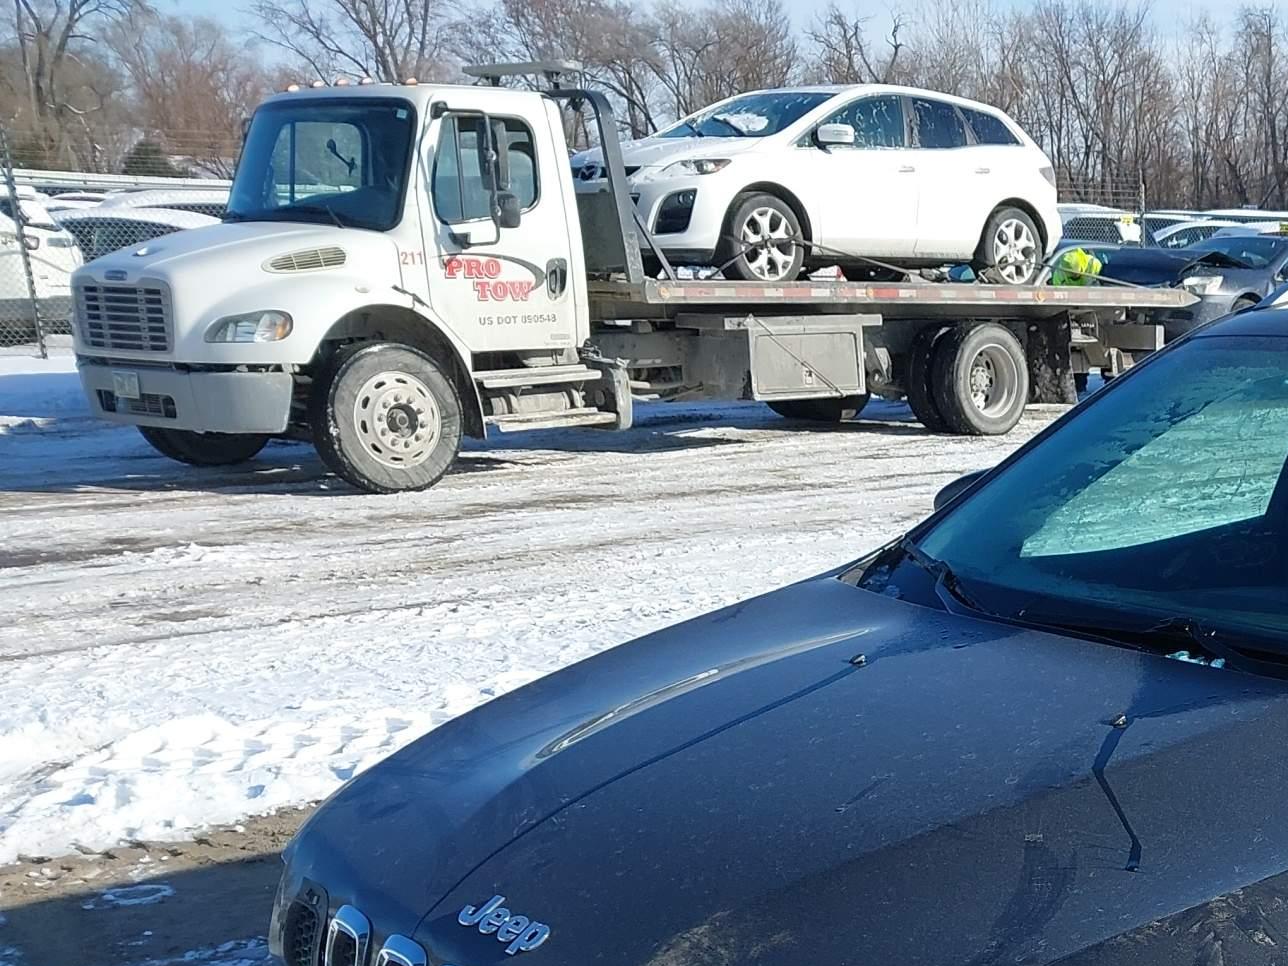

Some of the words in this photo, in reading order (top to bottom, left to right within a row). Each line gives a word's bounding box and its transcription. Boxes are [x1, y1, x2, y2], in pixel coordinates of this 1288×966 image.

[400, 251, 424, 265] 211
[445, 256, 501, 279] PRO
[474, 280, 533, 301] TOW
[479, 316, 493, 326] US
[497, 315, 517, 325] DOT
[458, 894, 551, 956] Jeep
